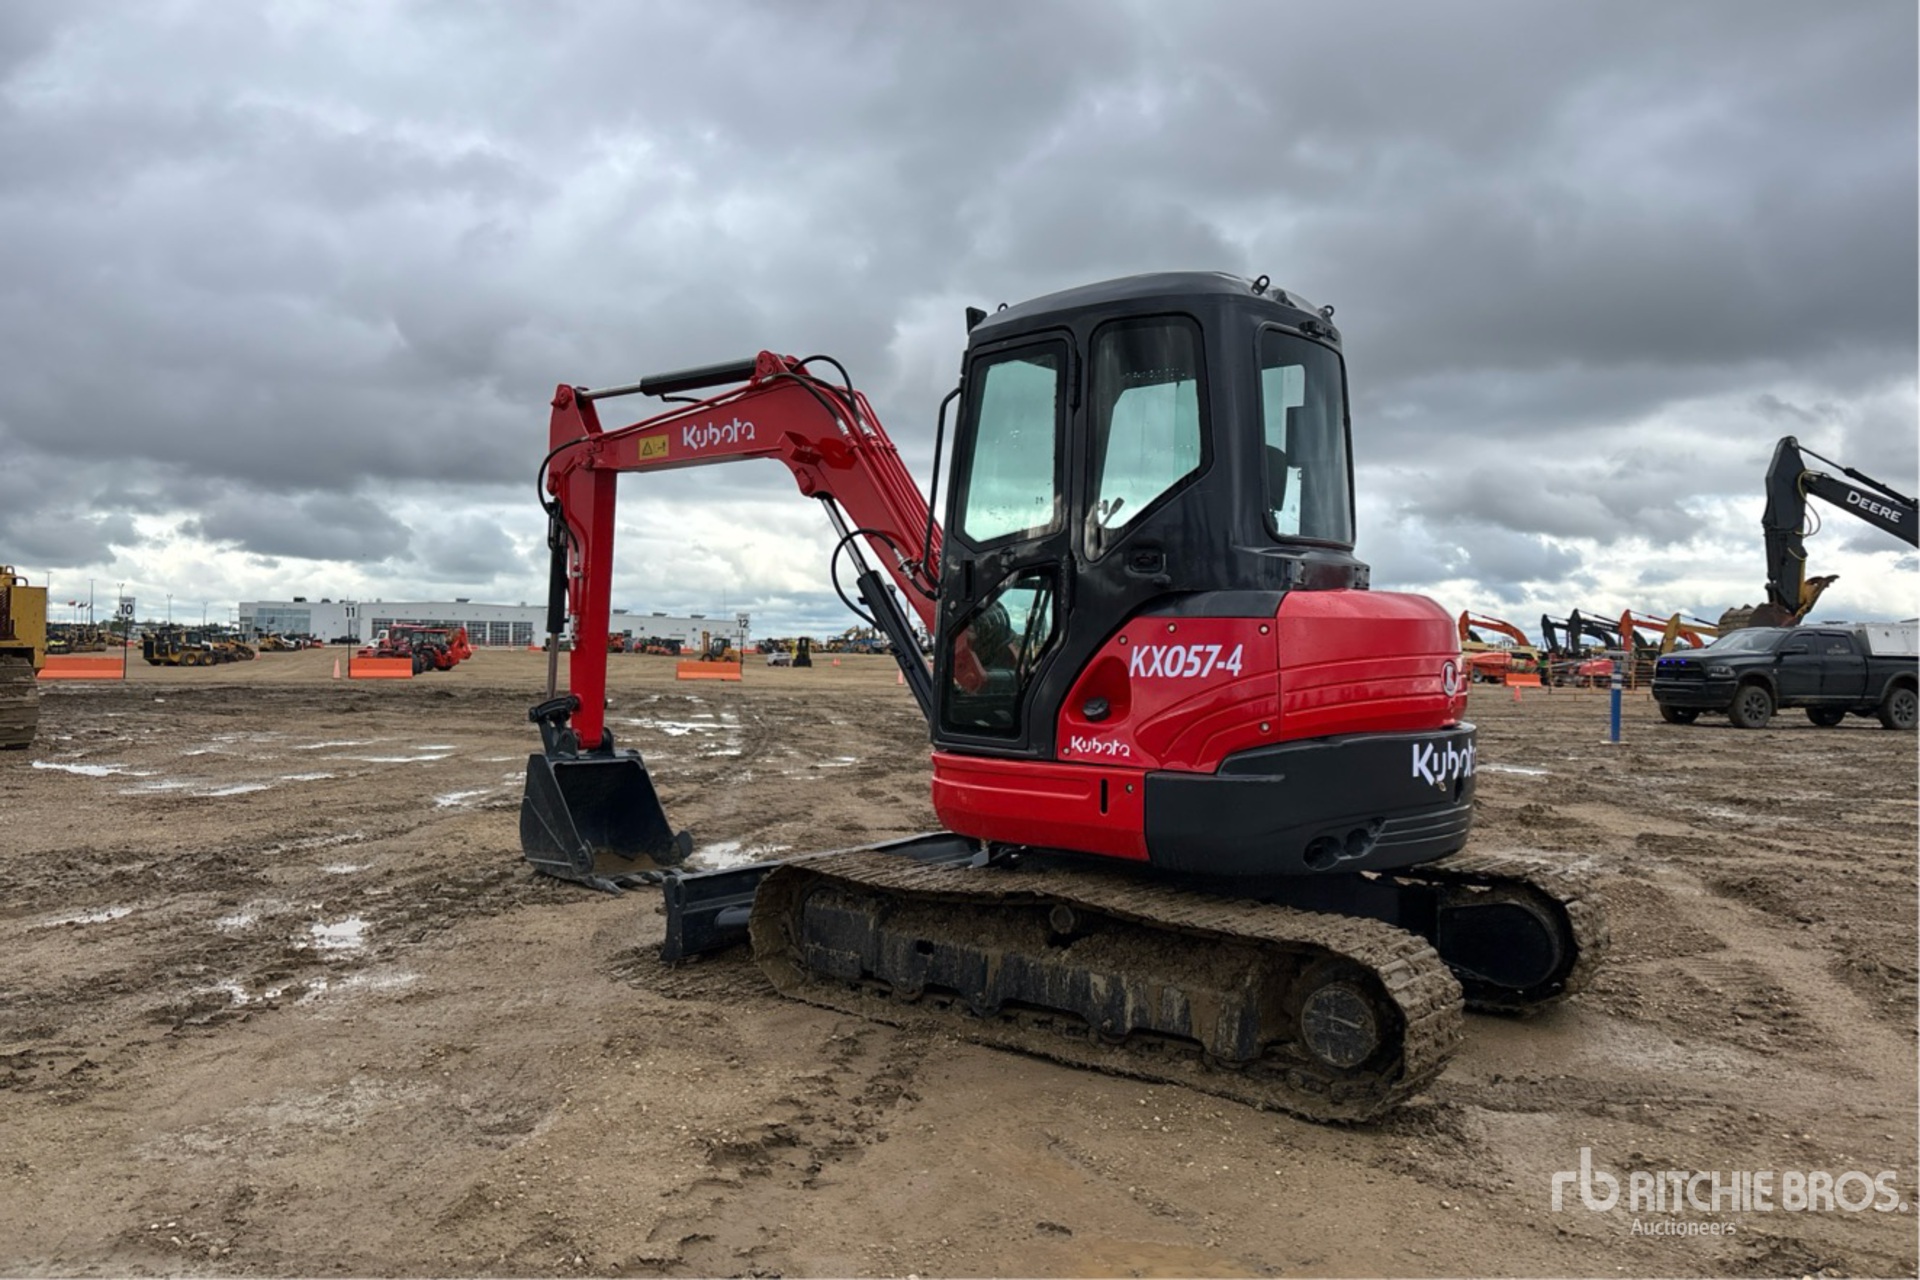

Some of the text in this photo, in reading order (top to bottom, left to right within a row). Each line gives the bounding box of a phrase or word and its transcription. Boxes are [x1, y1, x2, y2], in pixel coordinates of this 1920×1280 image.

[683, 417, 755, 450] Kubota
[1847, 490, 1902, 523] DEERE
[121, 603, 133, 615] 10
[345, 606, 355, 618] 11
[738, 618, 749, 628] 12
[1129, 644, 1243, 677] KX057-4
[1071, 735, 1130, 757] Kubota
